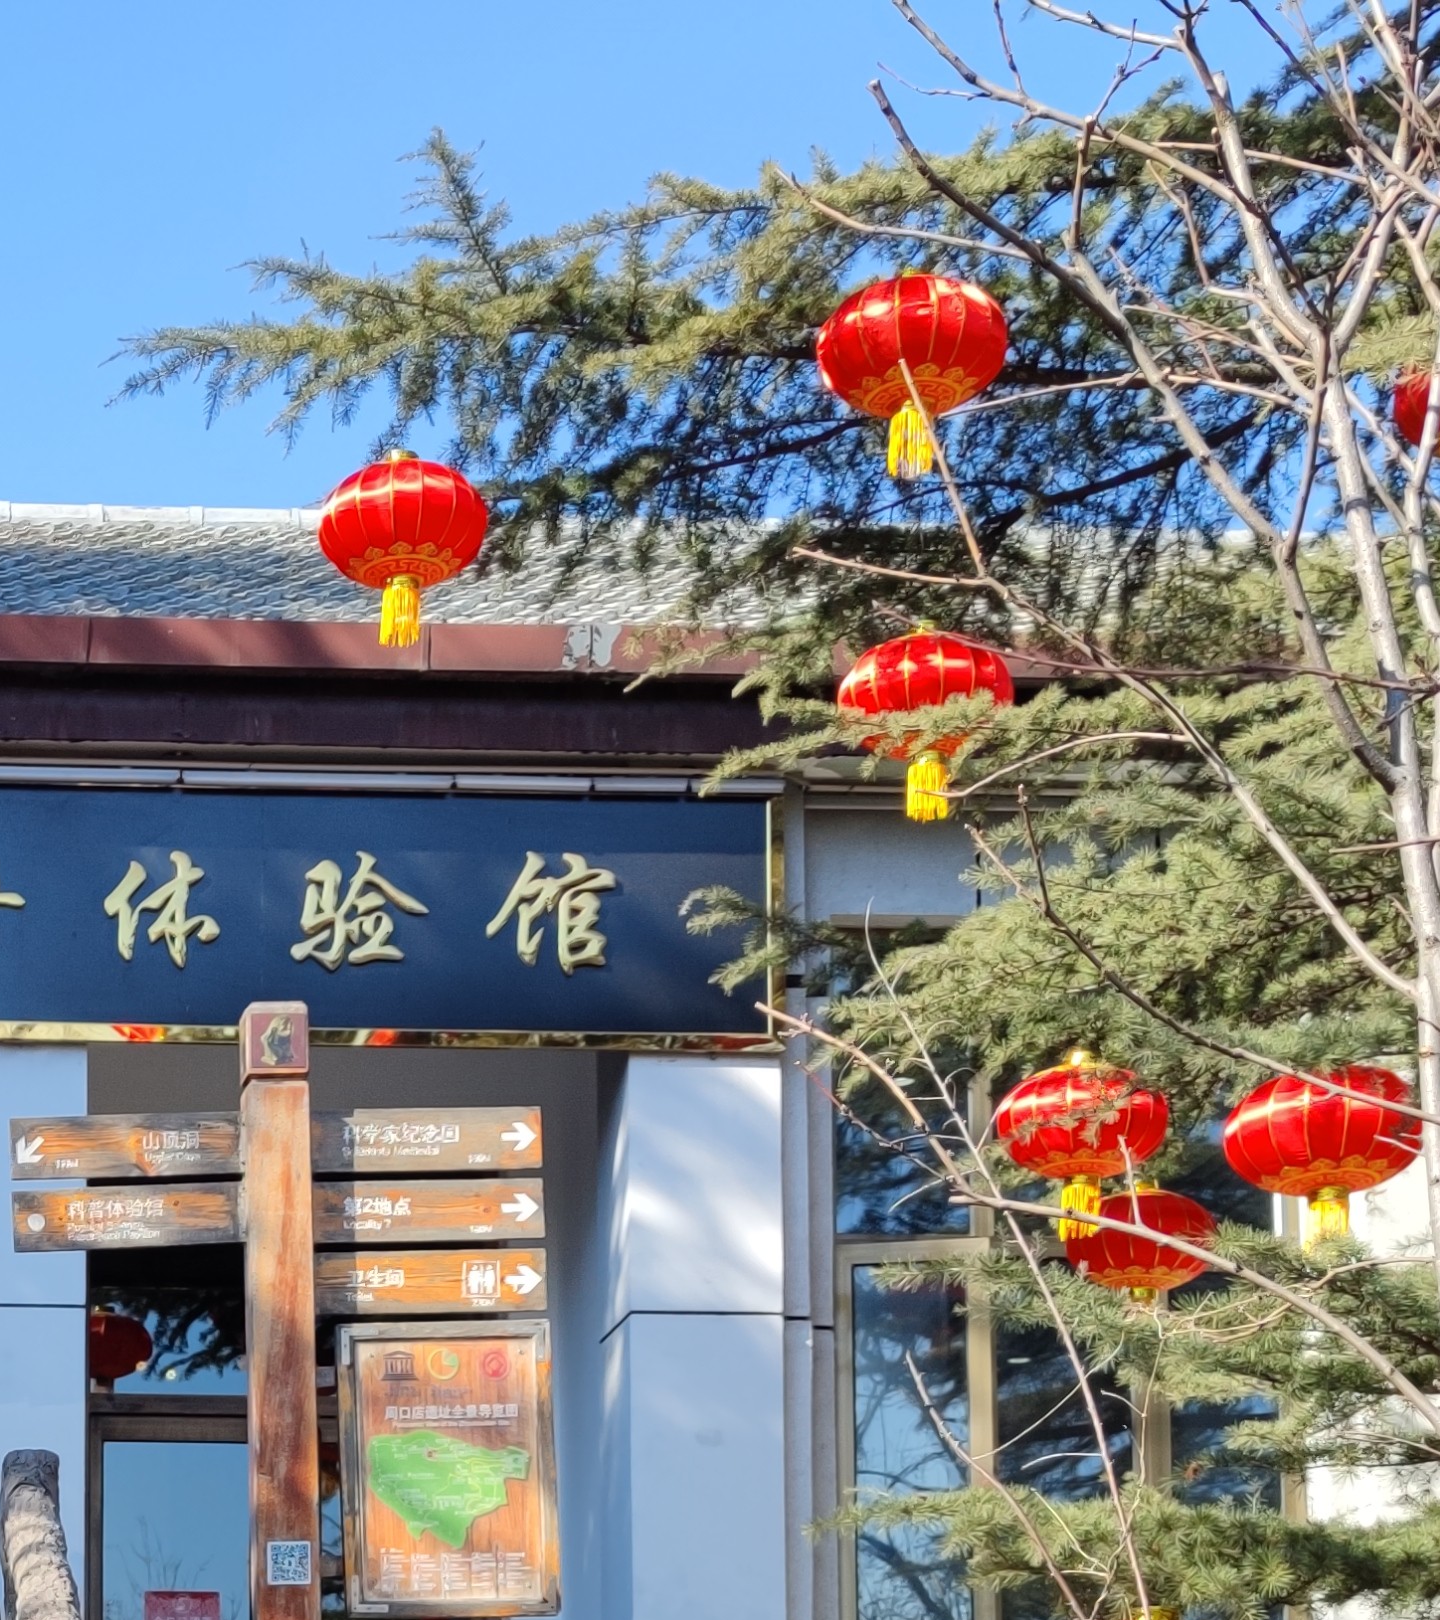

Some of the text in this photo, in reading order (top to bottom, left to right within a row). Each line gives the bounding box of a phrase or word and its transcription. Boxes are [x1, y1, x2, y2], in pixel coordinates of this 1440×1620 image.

[68, 1198, 164, 1220] 科普体验馆
[343, 1196, 412, 1217] 第2地点
[346, 1265, 405, 1289] 卫生间
